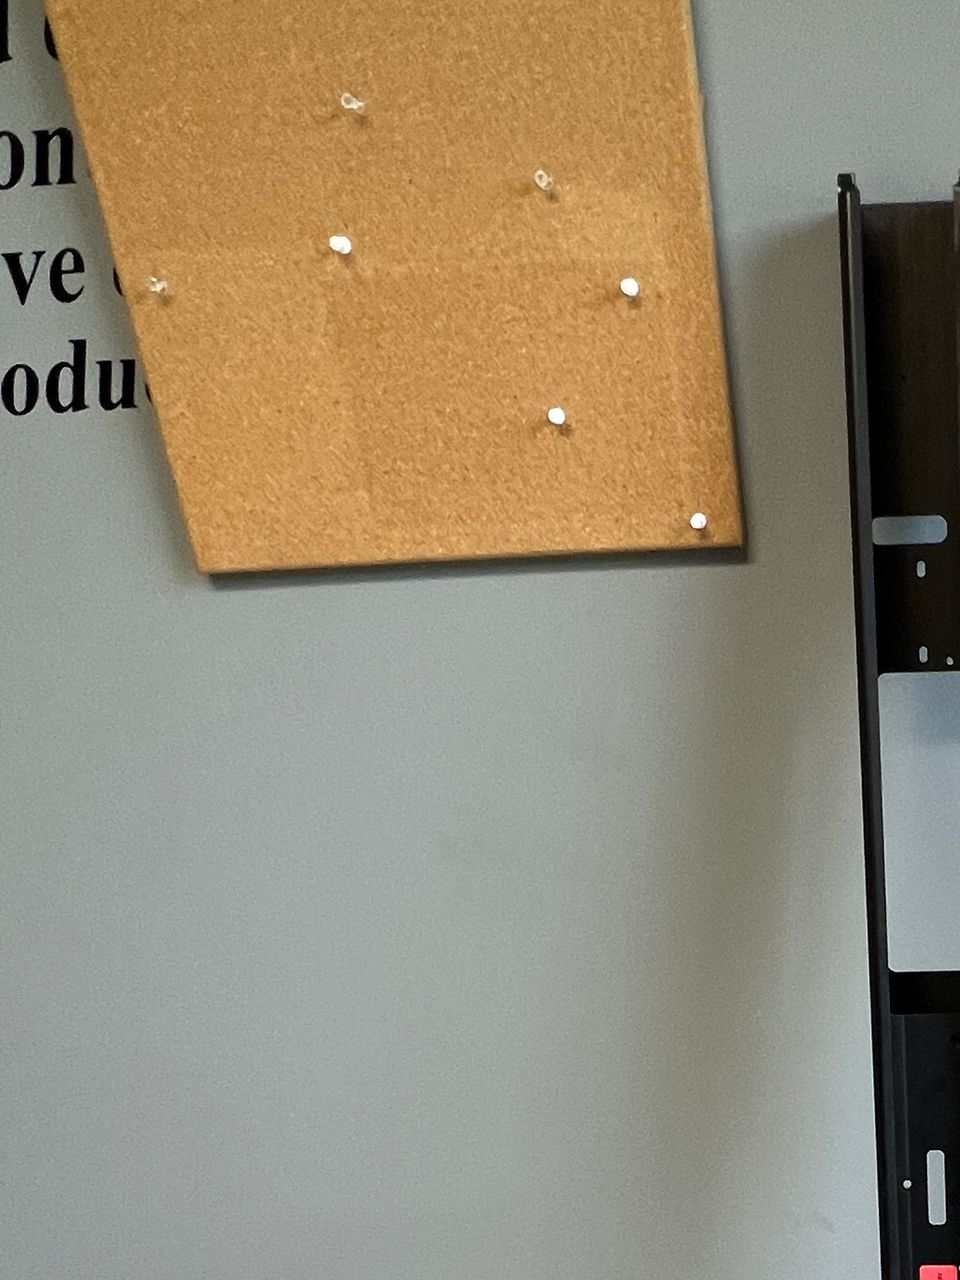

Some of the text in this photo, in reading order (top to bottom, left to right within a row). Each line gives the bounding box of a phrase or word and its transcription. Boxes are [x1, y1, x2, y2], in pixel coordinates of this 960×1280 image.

[0, 126, 77, 191] on
[1, 246, 86, 307] ve
[1, 339, 154, 417] odu
